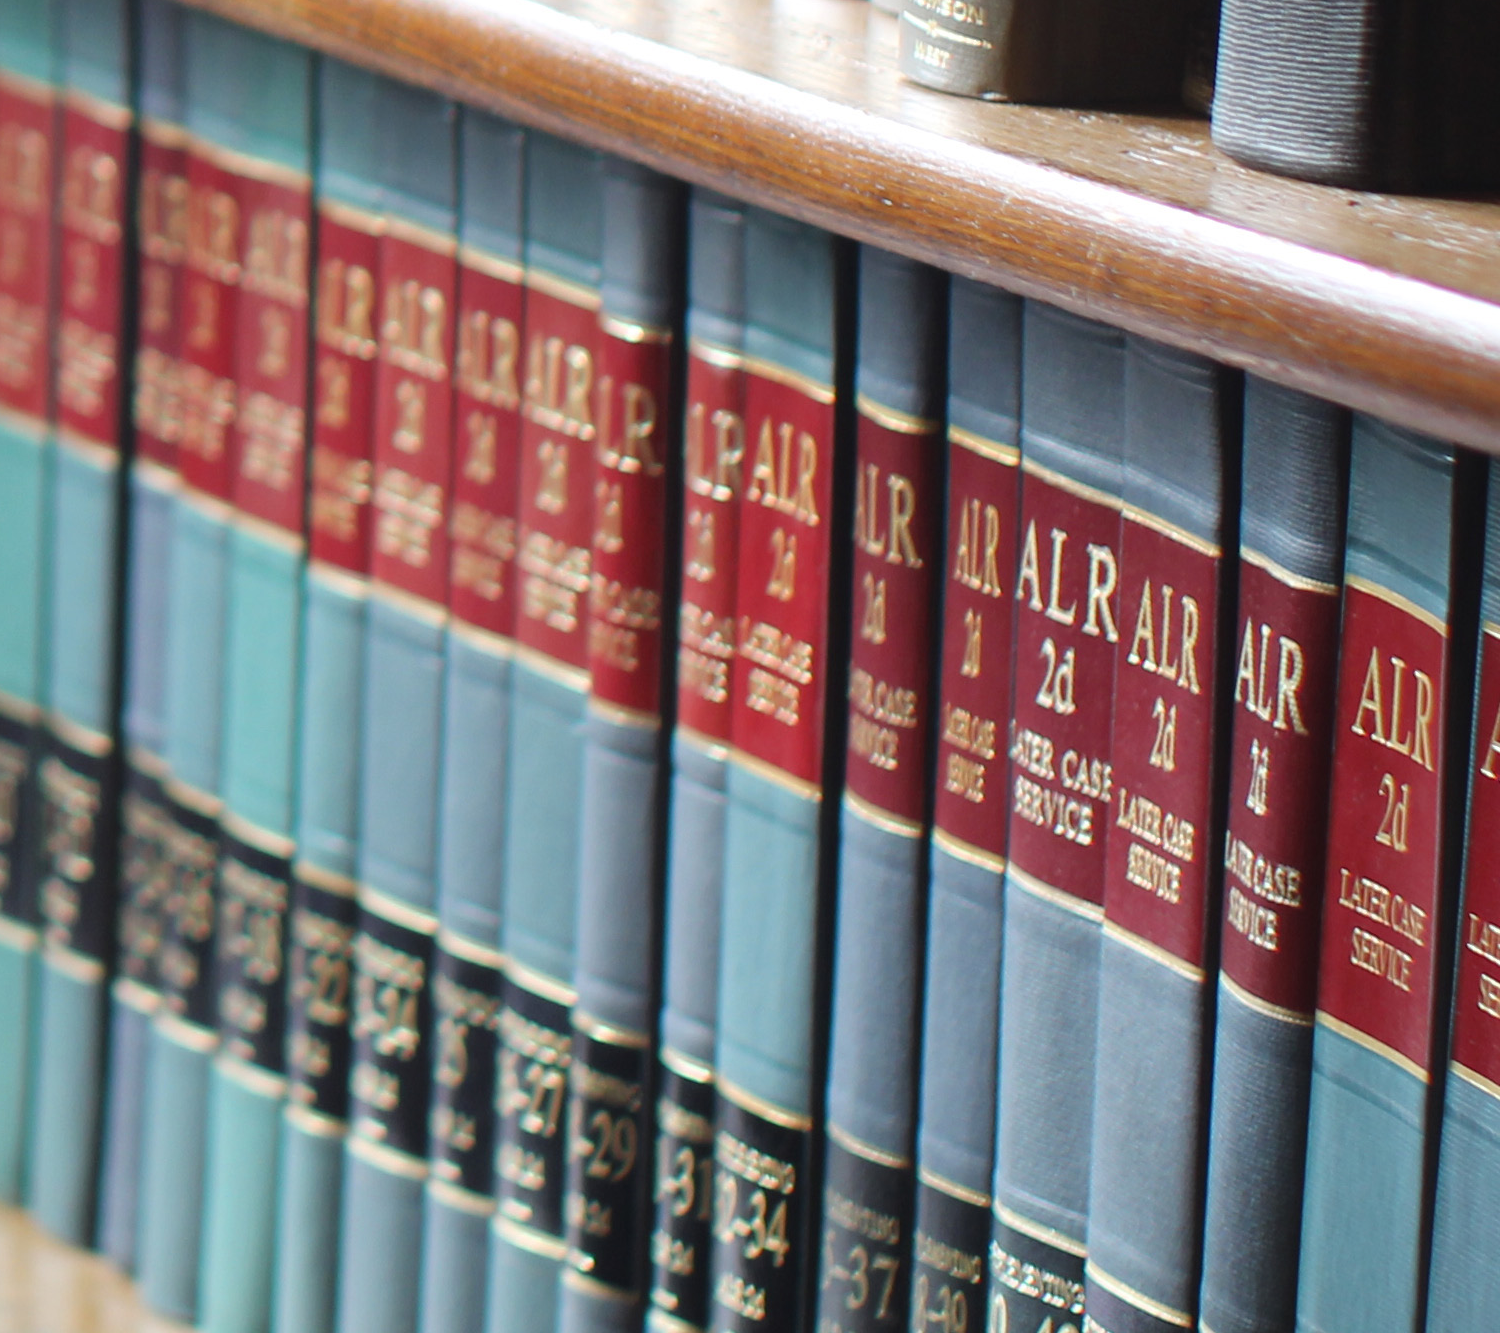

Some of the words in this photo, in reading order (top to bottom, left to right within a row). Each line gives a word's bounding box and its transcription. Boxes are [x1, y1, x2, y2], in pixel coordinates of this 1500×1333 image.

[746, 415, 820, 527] ALR
[953, 493, 1003, 599] ALR
[1015, 517, 1120, 644] ALR
[1036, 635, 1077, 717] 2d
[1126, 575, 1201, 696] ALR
[1234, 615, 1309, 736] ALR
[1148, 694, 1178, 773] 2d
[1350, 645, 1436, 773] ALR
[1013, 773, 1094, 848] SERVICE
[1060, 748, 1113, 804] CASE
[1374, 771, 1410, 854] 2d
[1116, 786, 1162, 847] LATER
[1161, 811, 1197, 863] CASE
[1125, 841, 1182, 905] SERVICE
[1252, 852, 1301, 909] CASE
[1337, 866, 1391, 927] LATER
[1390, 891, 1429, 948] CASE
[1227, 884, 1280, 952] SERVICE
[1350, 925, 1415, 994] SERVICE
